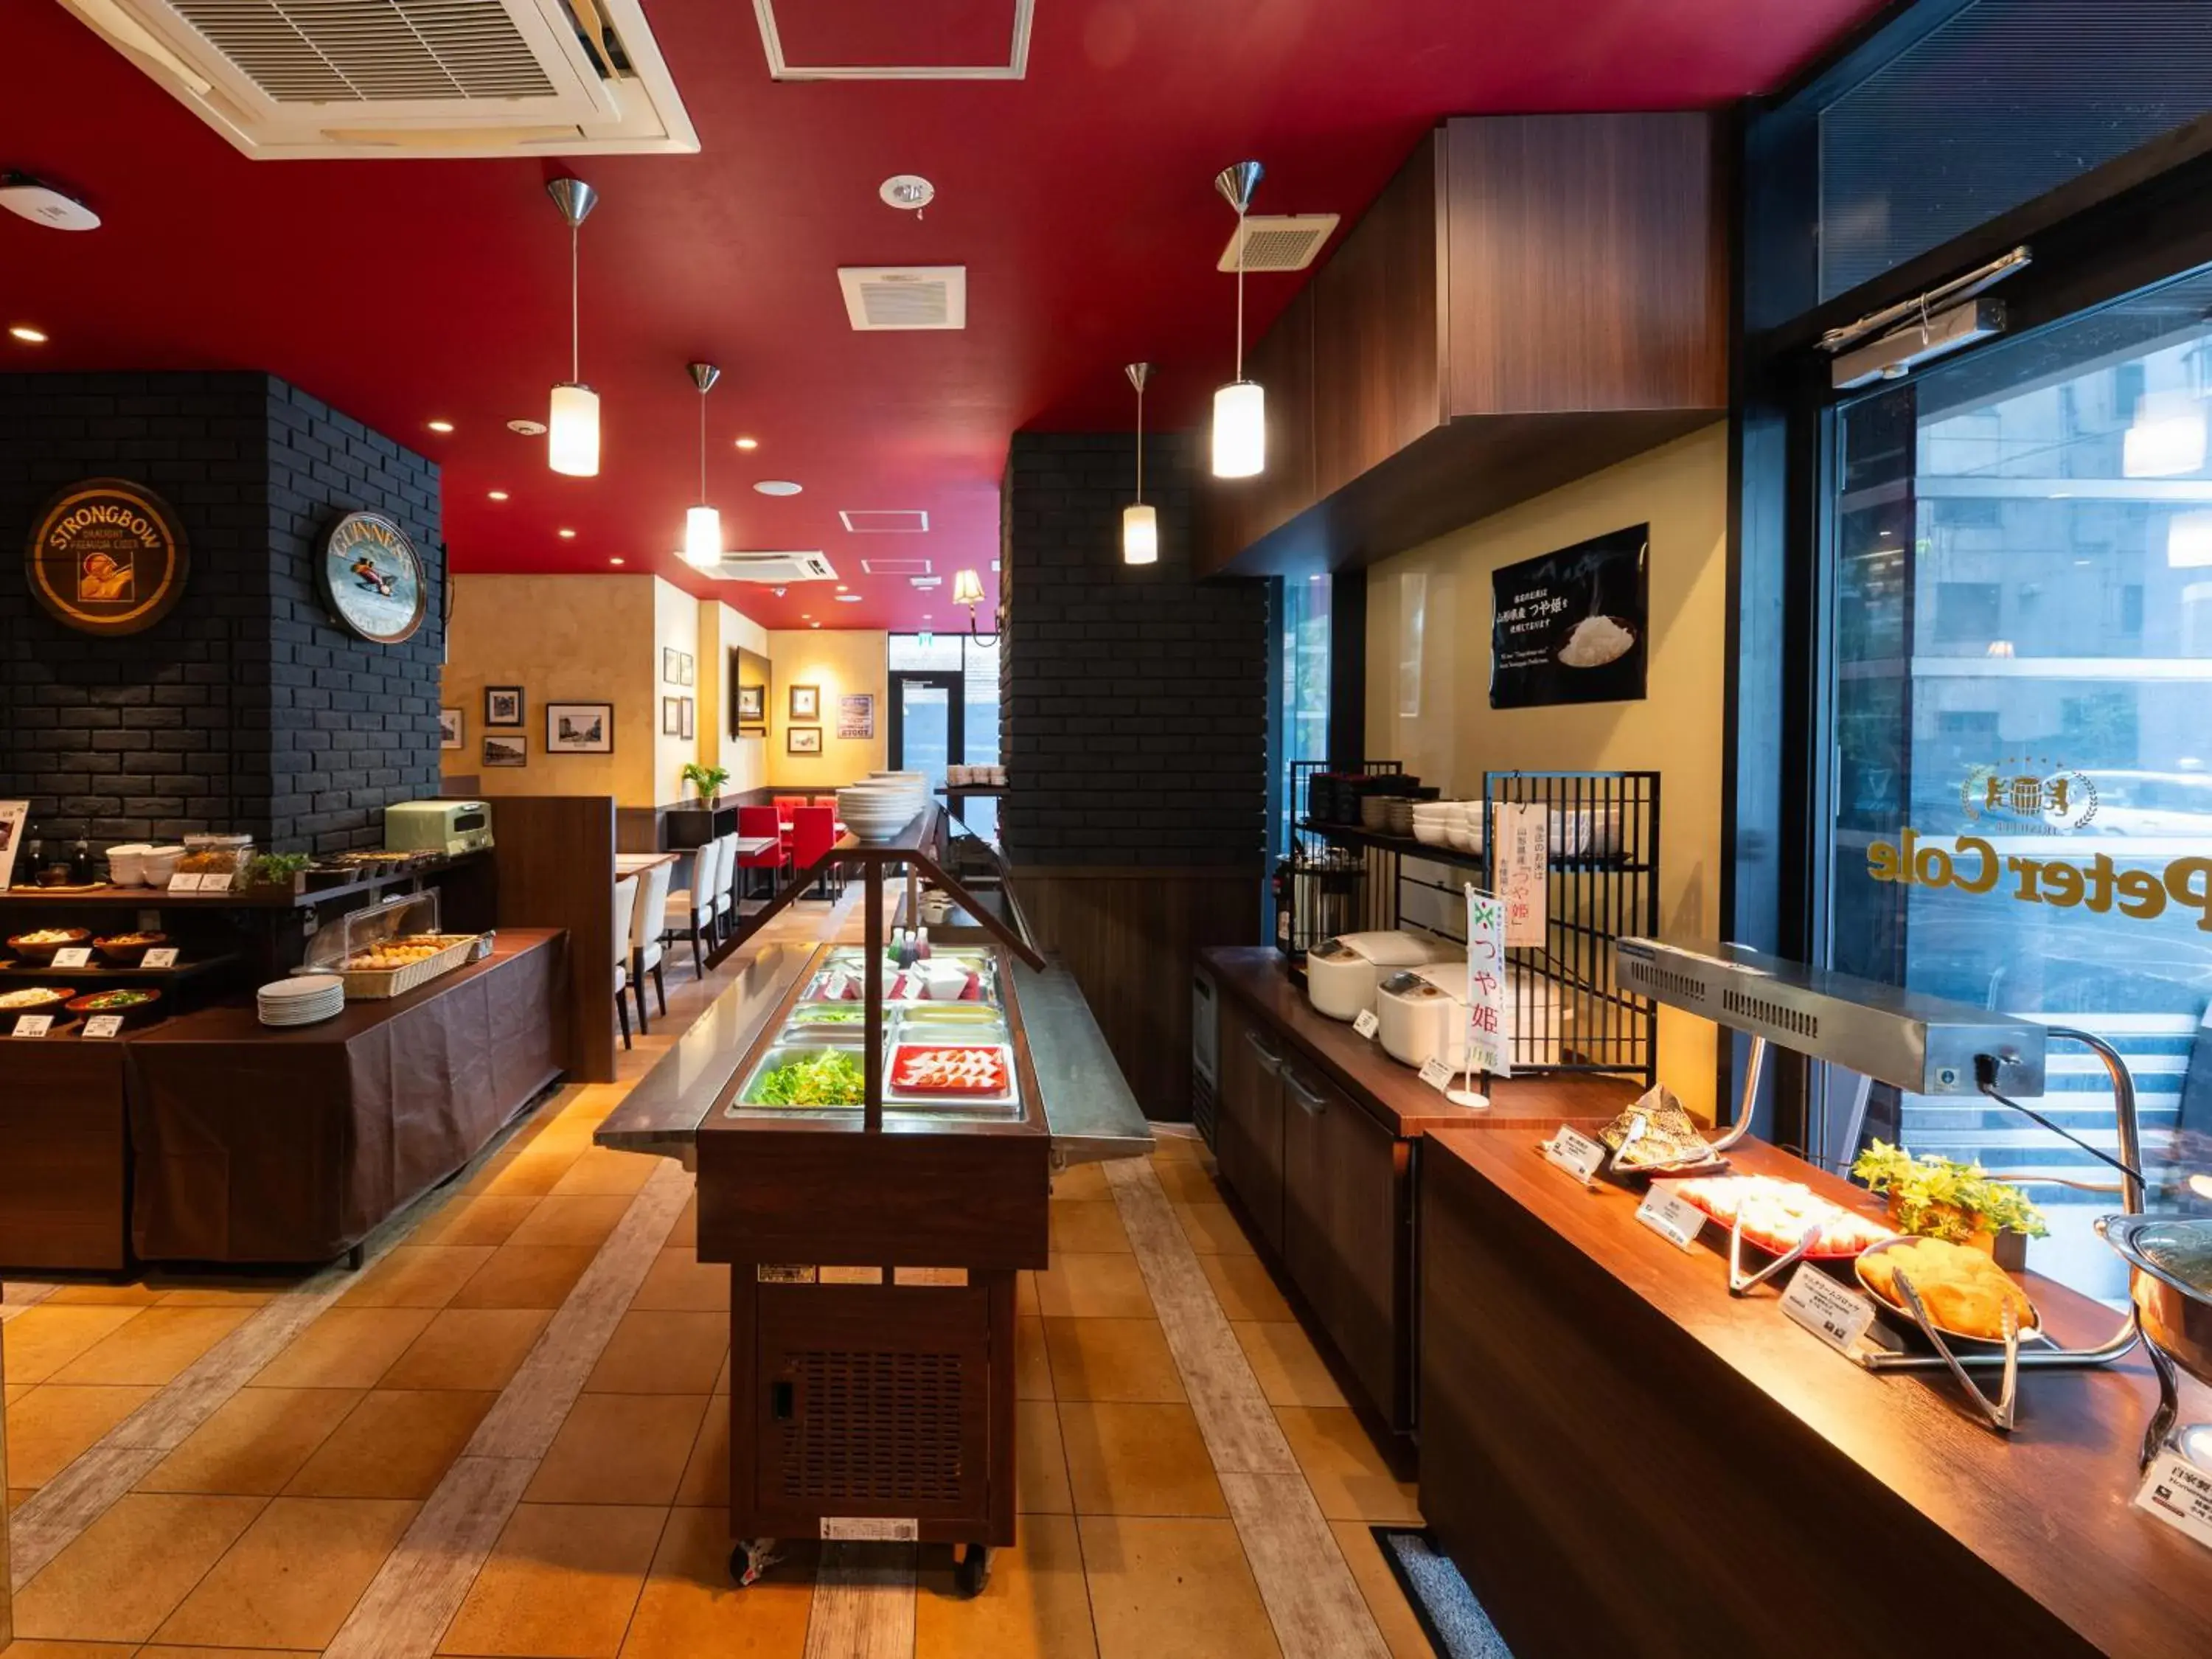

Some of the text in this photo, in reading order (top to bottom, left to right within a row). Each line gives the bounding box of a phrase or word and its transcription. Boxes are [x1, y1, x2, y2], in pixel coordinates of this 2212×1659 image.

[50, 504, 161, 551] STRONGBOW
[1472, 940, 1498, 1034] つや姫
